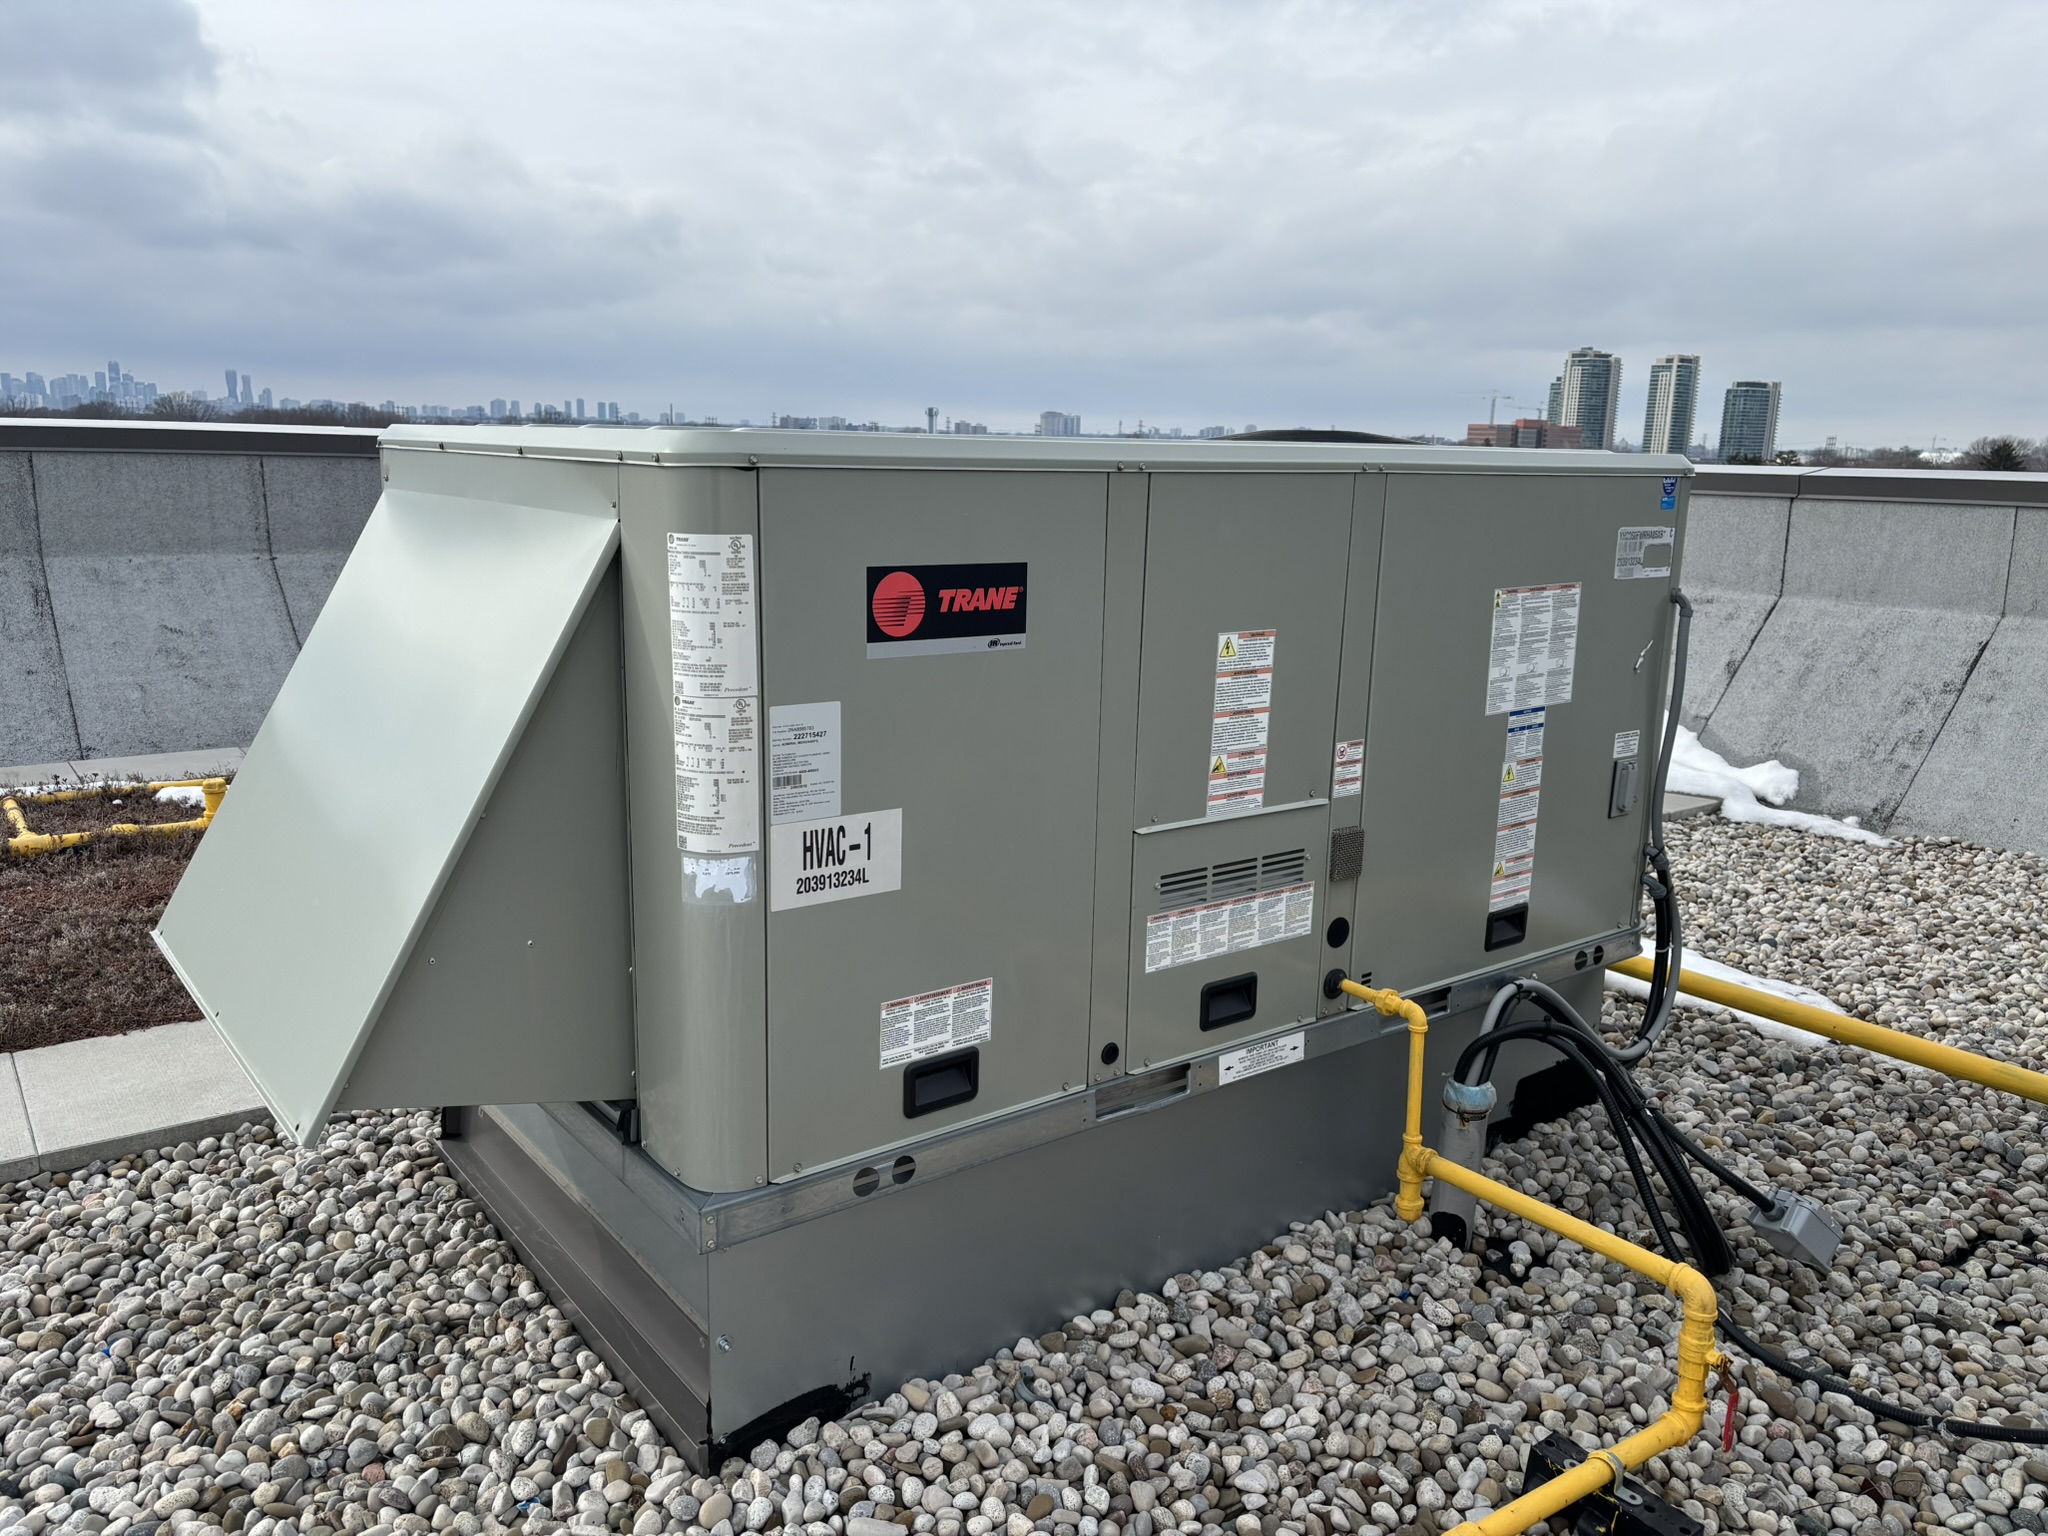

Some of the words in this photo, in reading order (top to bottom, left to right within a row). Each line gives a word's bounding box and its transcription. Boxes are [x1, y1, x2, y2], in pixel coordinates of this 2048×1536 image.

[938, 586, 1019, 613] TRANE
[793, 730, 827, 740] 222715427
[803, 822, 871, 871] HVAC-1
[796, 867, 870, 895] 203913234L
[1246, 1040, 1279, 1054] IMPORTANT
